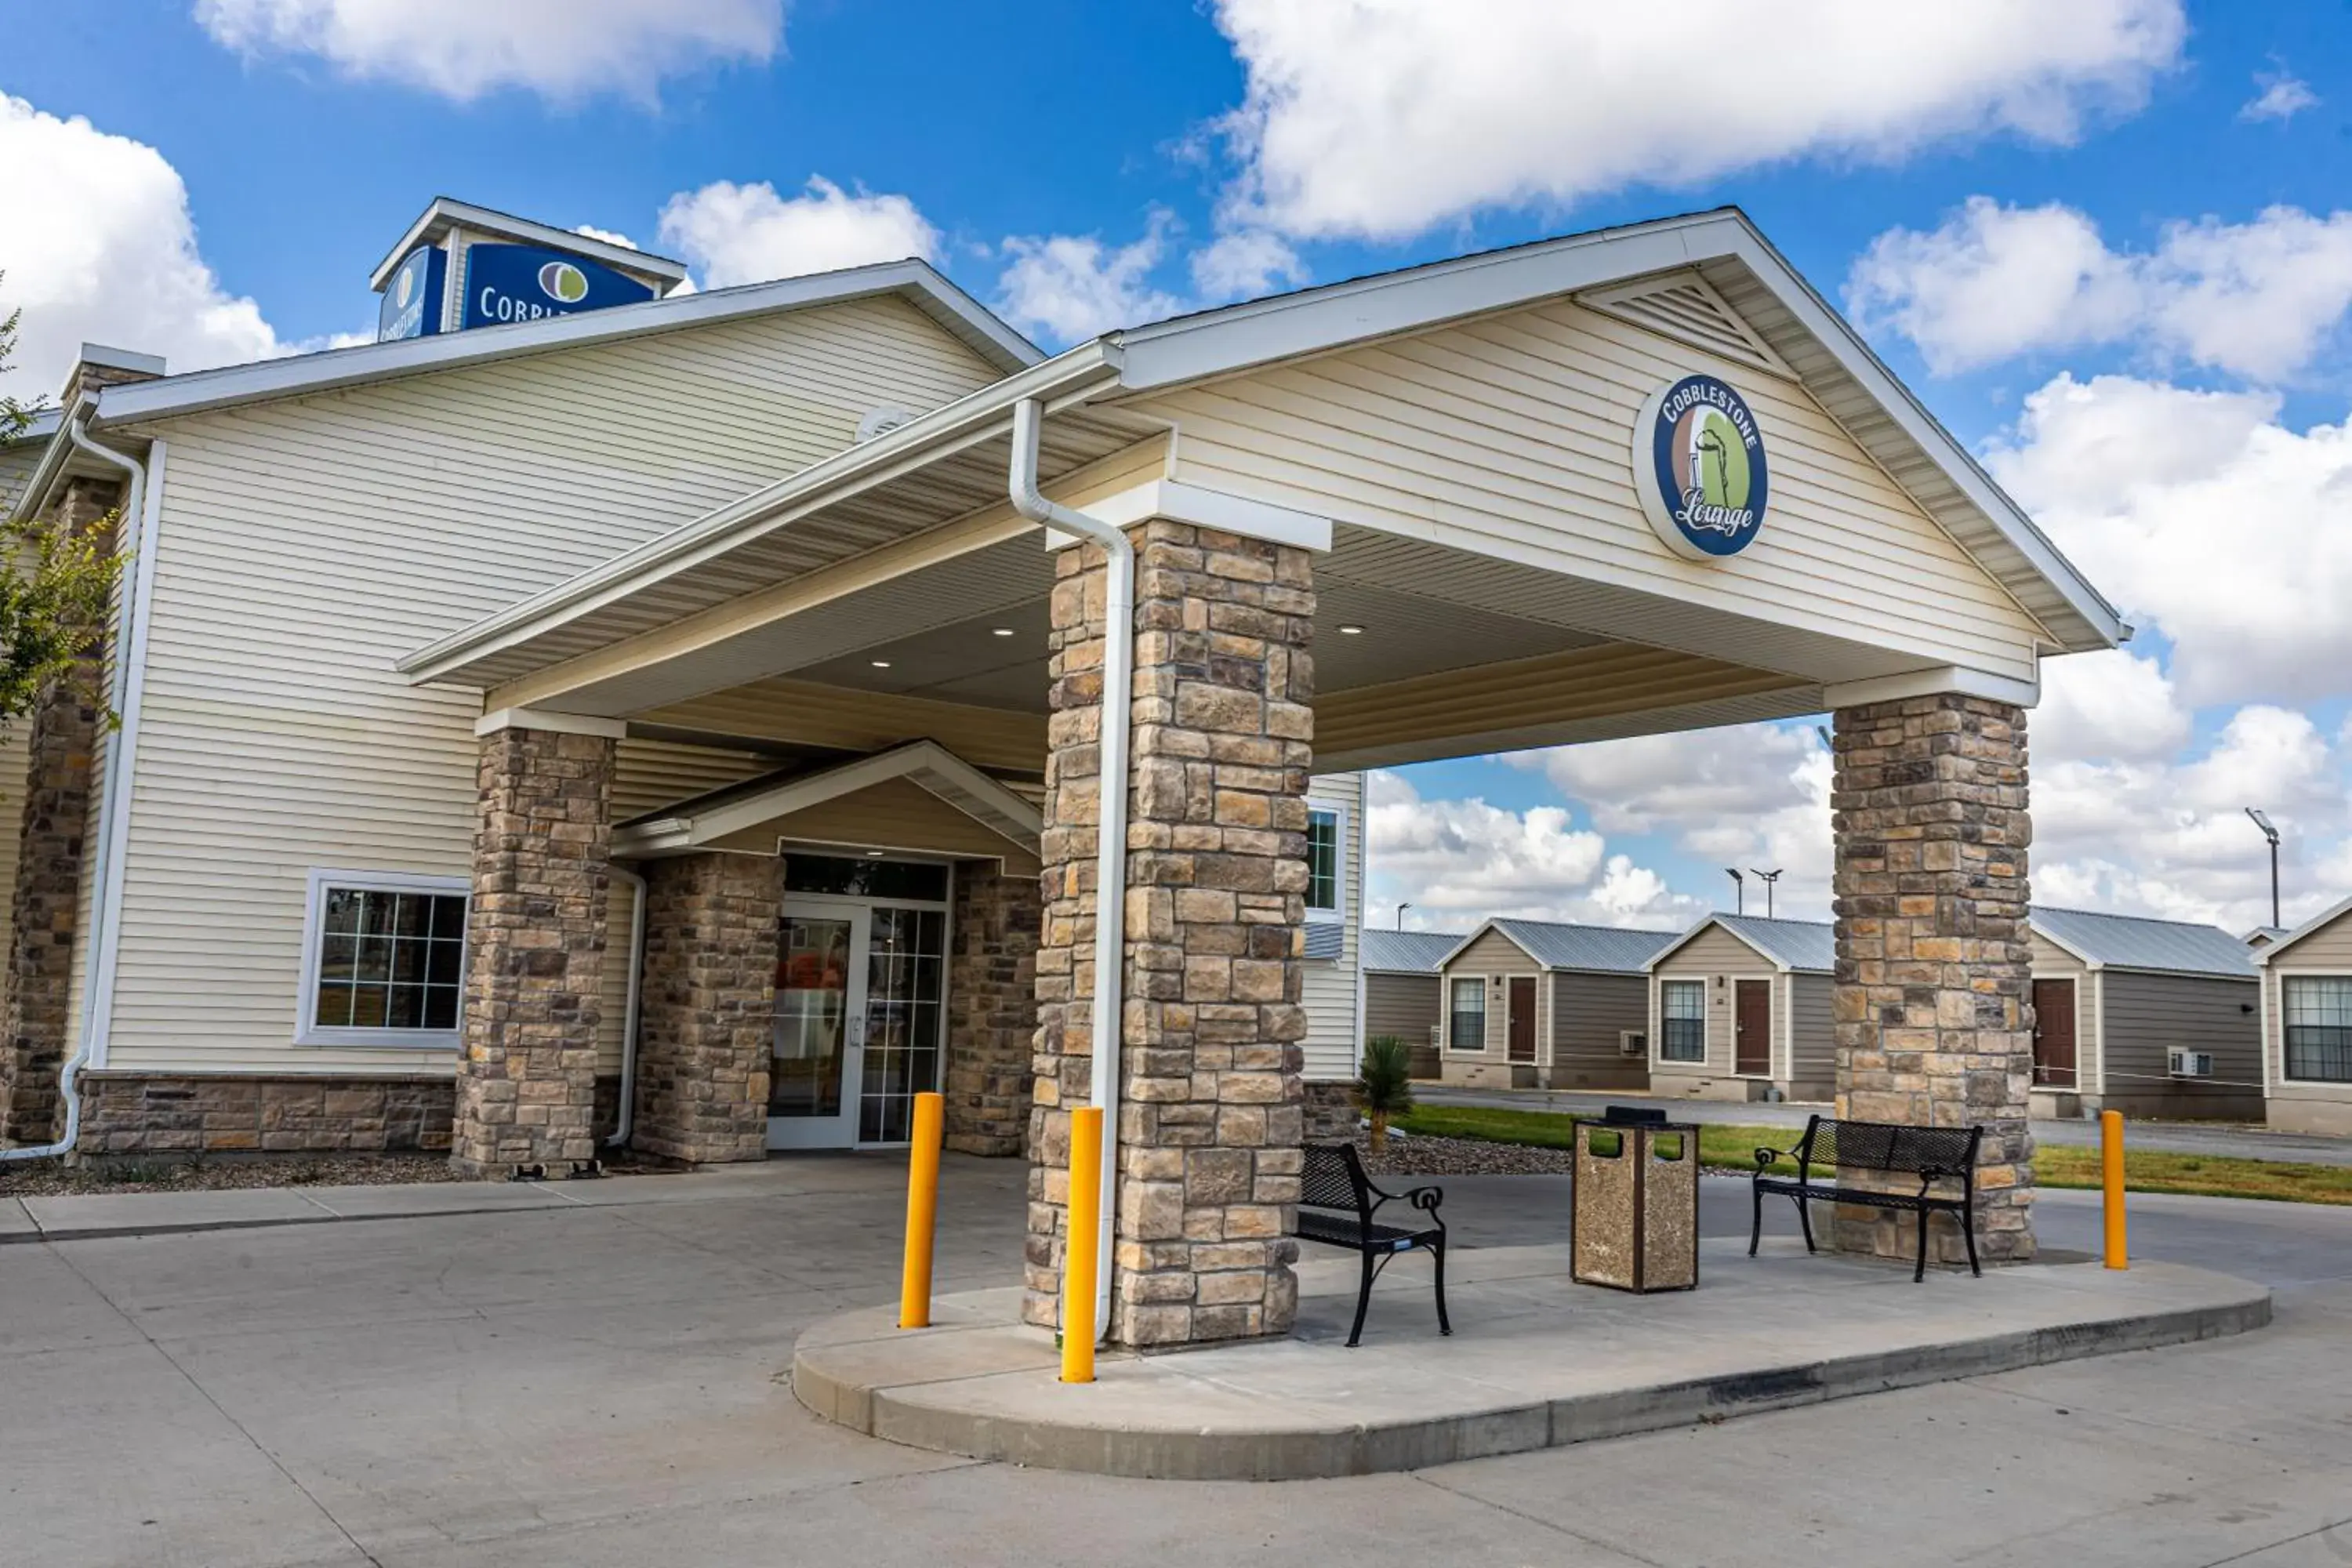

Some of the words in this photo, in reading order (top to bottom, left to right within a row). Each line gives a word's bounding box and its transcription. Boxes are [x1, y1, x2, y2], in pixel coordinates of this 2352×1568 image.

[481, 286, 568, 322] COBB
[1663, 383, 1757, 449] COBBLESTONE
[1675, 488, 1753, 537] Lounge
